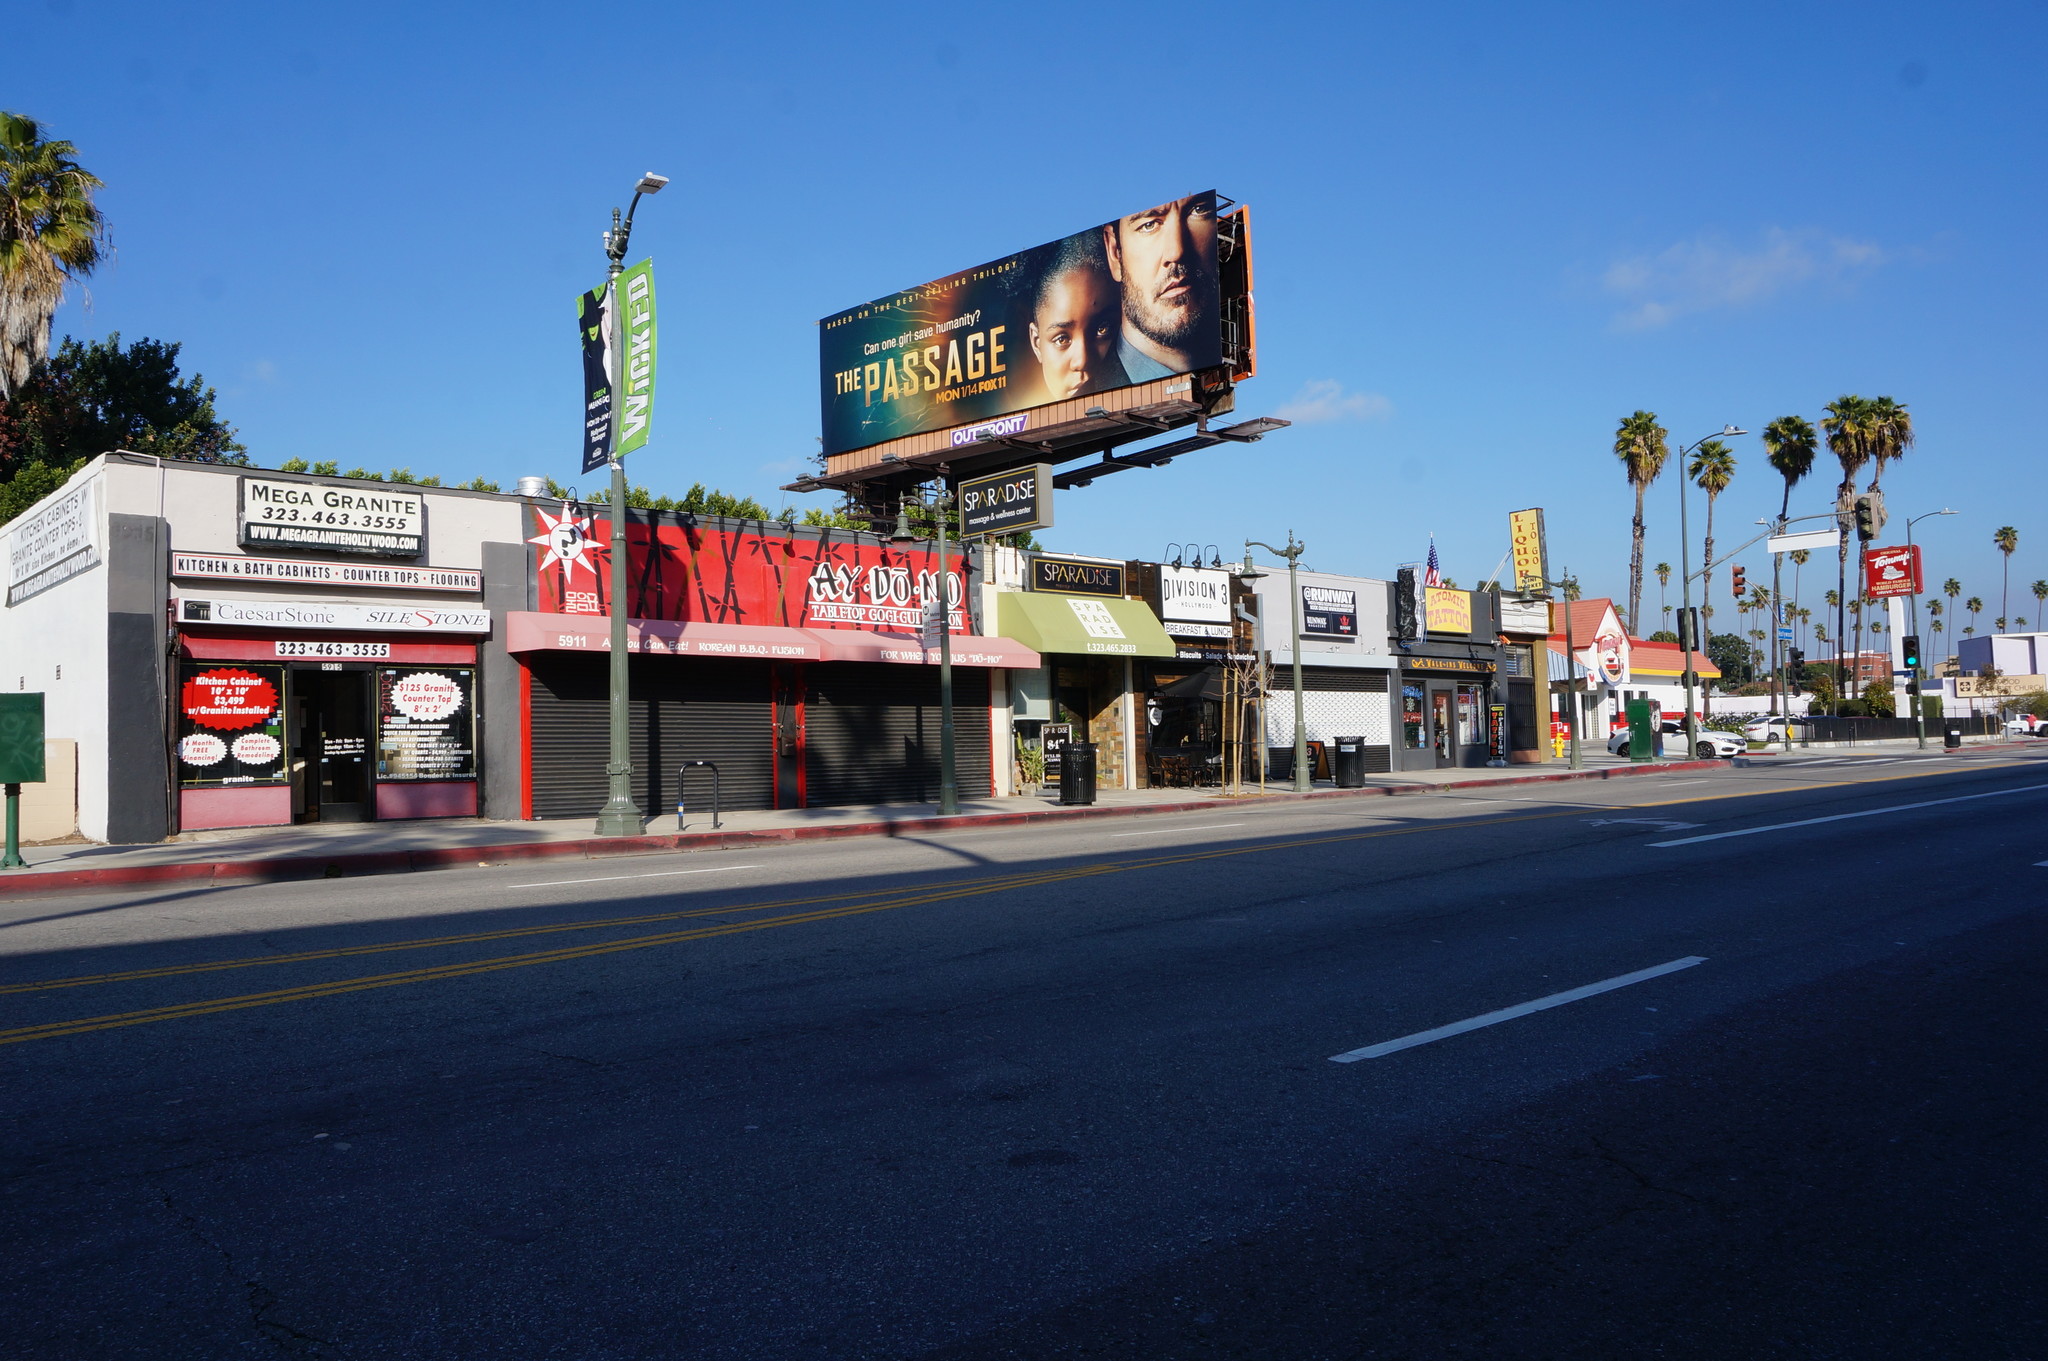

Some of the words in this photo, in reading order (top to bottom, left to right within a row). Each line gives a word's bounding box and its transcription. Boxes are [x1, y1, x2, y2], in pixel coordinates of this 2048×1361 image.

[827, 315, 853, 330] BASED
[858, 309, 869, 319] ON
[874, 302, 890, 314] THE
[896, 277, 966, 307] BEST-SELLING
[972, 260, 1017, 282] TRILOGY
[864, 340, 879, 356] Can
[881, 337, 897, 352] one
[898, 330, 912, 348] girl
[914, 327, 934, 343] save
[935, 309, 981, 335] humanity?
[622, 273, 651, 445] WICKED
[835, 367, 862, 395] THE
[864, 325, 1007, 408] PASSAGE
[935, 387, 961, 404] MON
[960, 383, 978, 398] 1/14
[252, 484, 314, 506] MEGA
[324, 491, 416, 515] GRANITE
[20, 517, 45, 543] KITCHEN
[47, 494, 79, 527] CABINETS
[261, 506, 407, 530] 323.463.3555
[968, 515, 990, 525] massage
[990, 512, 995, 521] &
[995, 509, 1015, 519] wellness
[1015, 506, 1032, 516] center
[250, 525, 418, 550] WWW.MEGAGRANITEHOLLYWOOD.COM
[1530, 522, 1537, 540] TO
[34, 528, 60, 554] COUNTER
[1513, 514, 1529, 578] LIQUOR
[1532, 547, 1539, 565] GO
[178, 558, 228, 573] KITCHEN
[233, 563, 240, 574] &
[245, 562, 273, 576] BATH
[277, 564, 331, 579] CABINETS
[343, 568, 390, 583] COUNTER
[394, 571, 419, 584] TOPS
[430, 573, 477, 587] FLOORING
[1163, 578, 1216, 601] DIVISION
[1221, 584, 1228, 605] 3
[1303, 587, 1354, 604] @RUNWAY
[1430, 591, 1466, 609] ATOMIC
[217, 603, 335, 624] CaesarStone
[811, 604, 866, 621] TABLETOP
[868, 610, 921, 625] GOGI-GUI
[1181, 602, 1213, 610] HOLLYWOOD
[1427, 608, 1470, 631] TATTOO
[1165, 624, 1202, 635] BREAKFAST
[1211, 626, 1232, 637] LUNCH
[558, 635, 587, 647] 5911
[644, 639, 665, 650] Can
[668, 640, 689, 651] Eat!
[698, 642, 736, 653] KOREAN
[739, 644, 768, 654] B.B.Q.
[771, 645, 805, 656] FUSION
[1086, 642, 1137, 653] t.323.465.2833
[880, 650, 899, 660] FOR
[900, 650, 928, 661] WHEN
[1179, 651, 1202, 659] Biscuits
[1205, 652, 1223, 660] Salads
[322, 663, 342, 671] 5915
[195, 676, 228, 686] Kitchen
[230, 677, 263, 686] Cabinet
[399, 683, 421, 692] $125
[424, 684, 455, 693] Granite
[210, 687, 225, 695] 10'
[235, 687, 250, 695] 10'
[402, 694, 435, 703] Counter
[438, 695, 452, 705] Top
[214, 695, 245, 706] $3,499
[414, 705, 422, 713] 8'
[433, 705, 441, 713] 2'
[232, 706, 270, 715] Installed
[222, 775, 255, 785] granite
